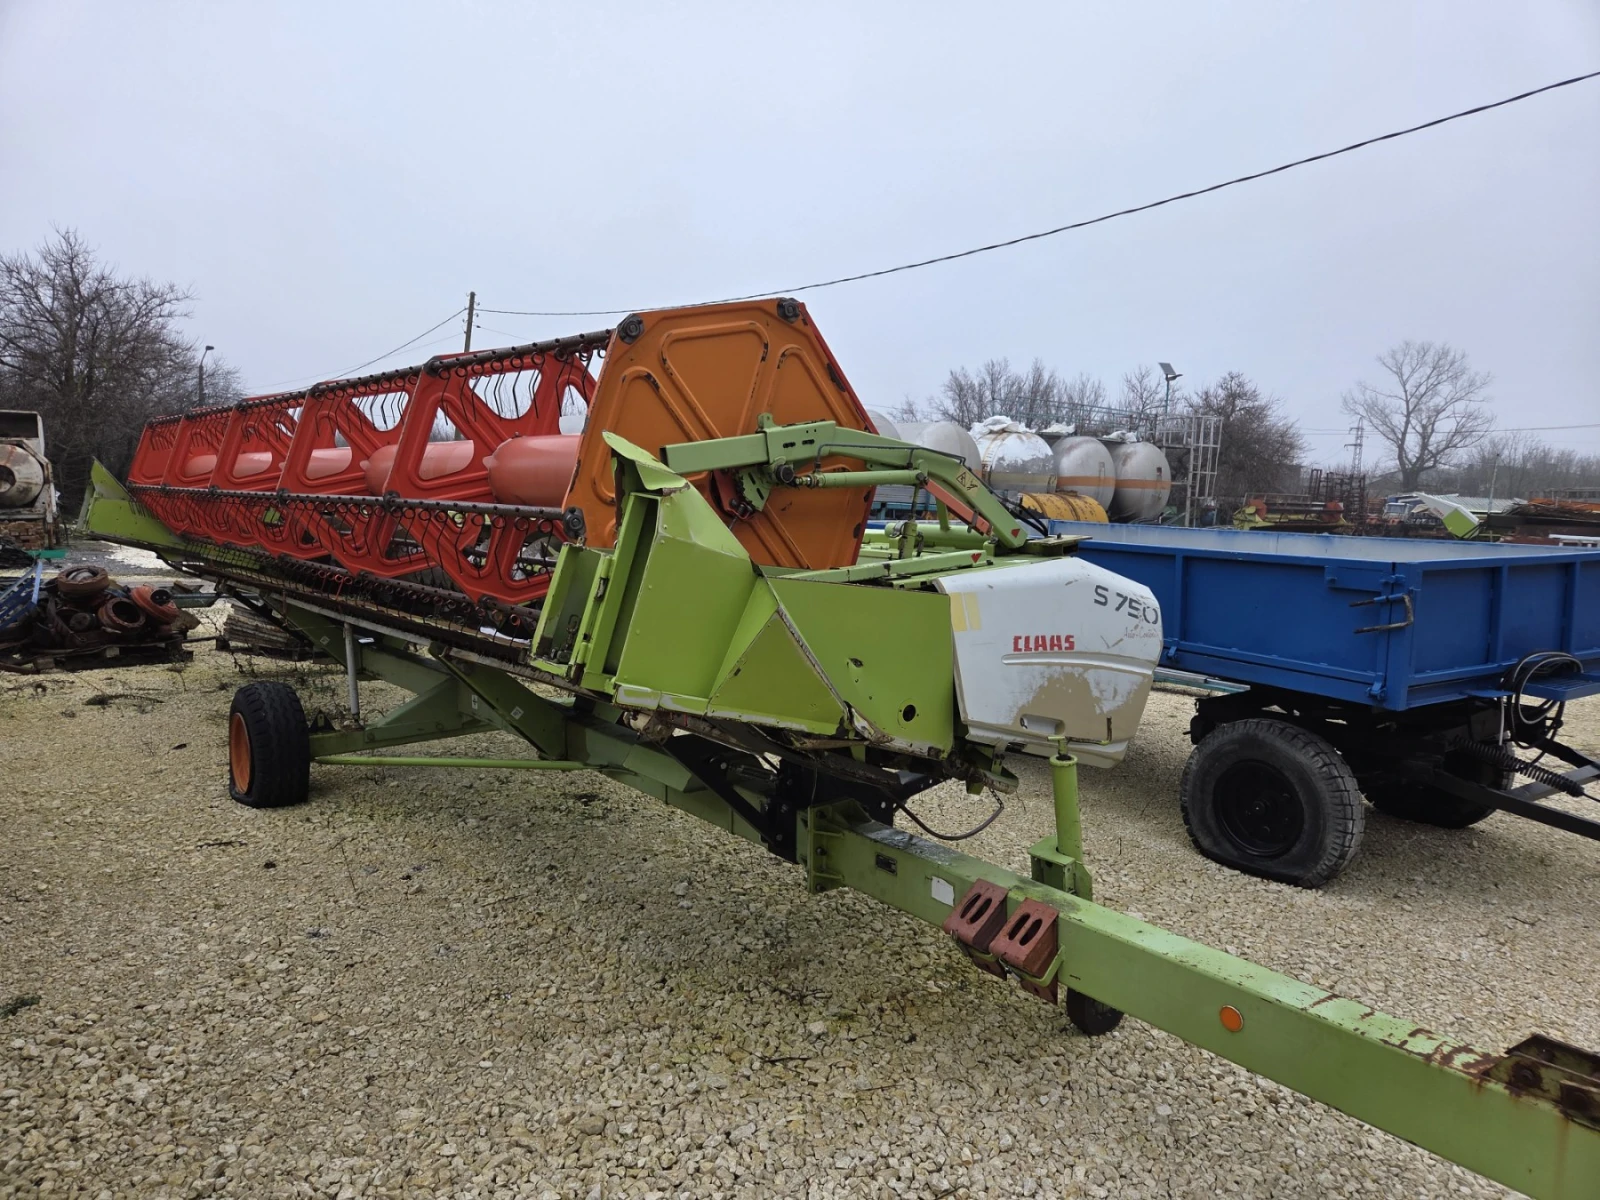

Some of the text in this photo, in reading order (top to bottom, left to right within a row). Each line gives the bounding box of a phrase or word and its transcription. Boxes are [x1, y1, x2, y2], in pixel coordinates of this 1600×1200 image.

[1094, 584, 1159, 625] S 750
[1013, 634, 1075, 652] CLAAS
